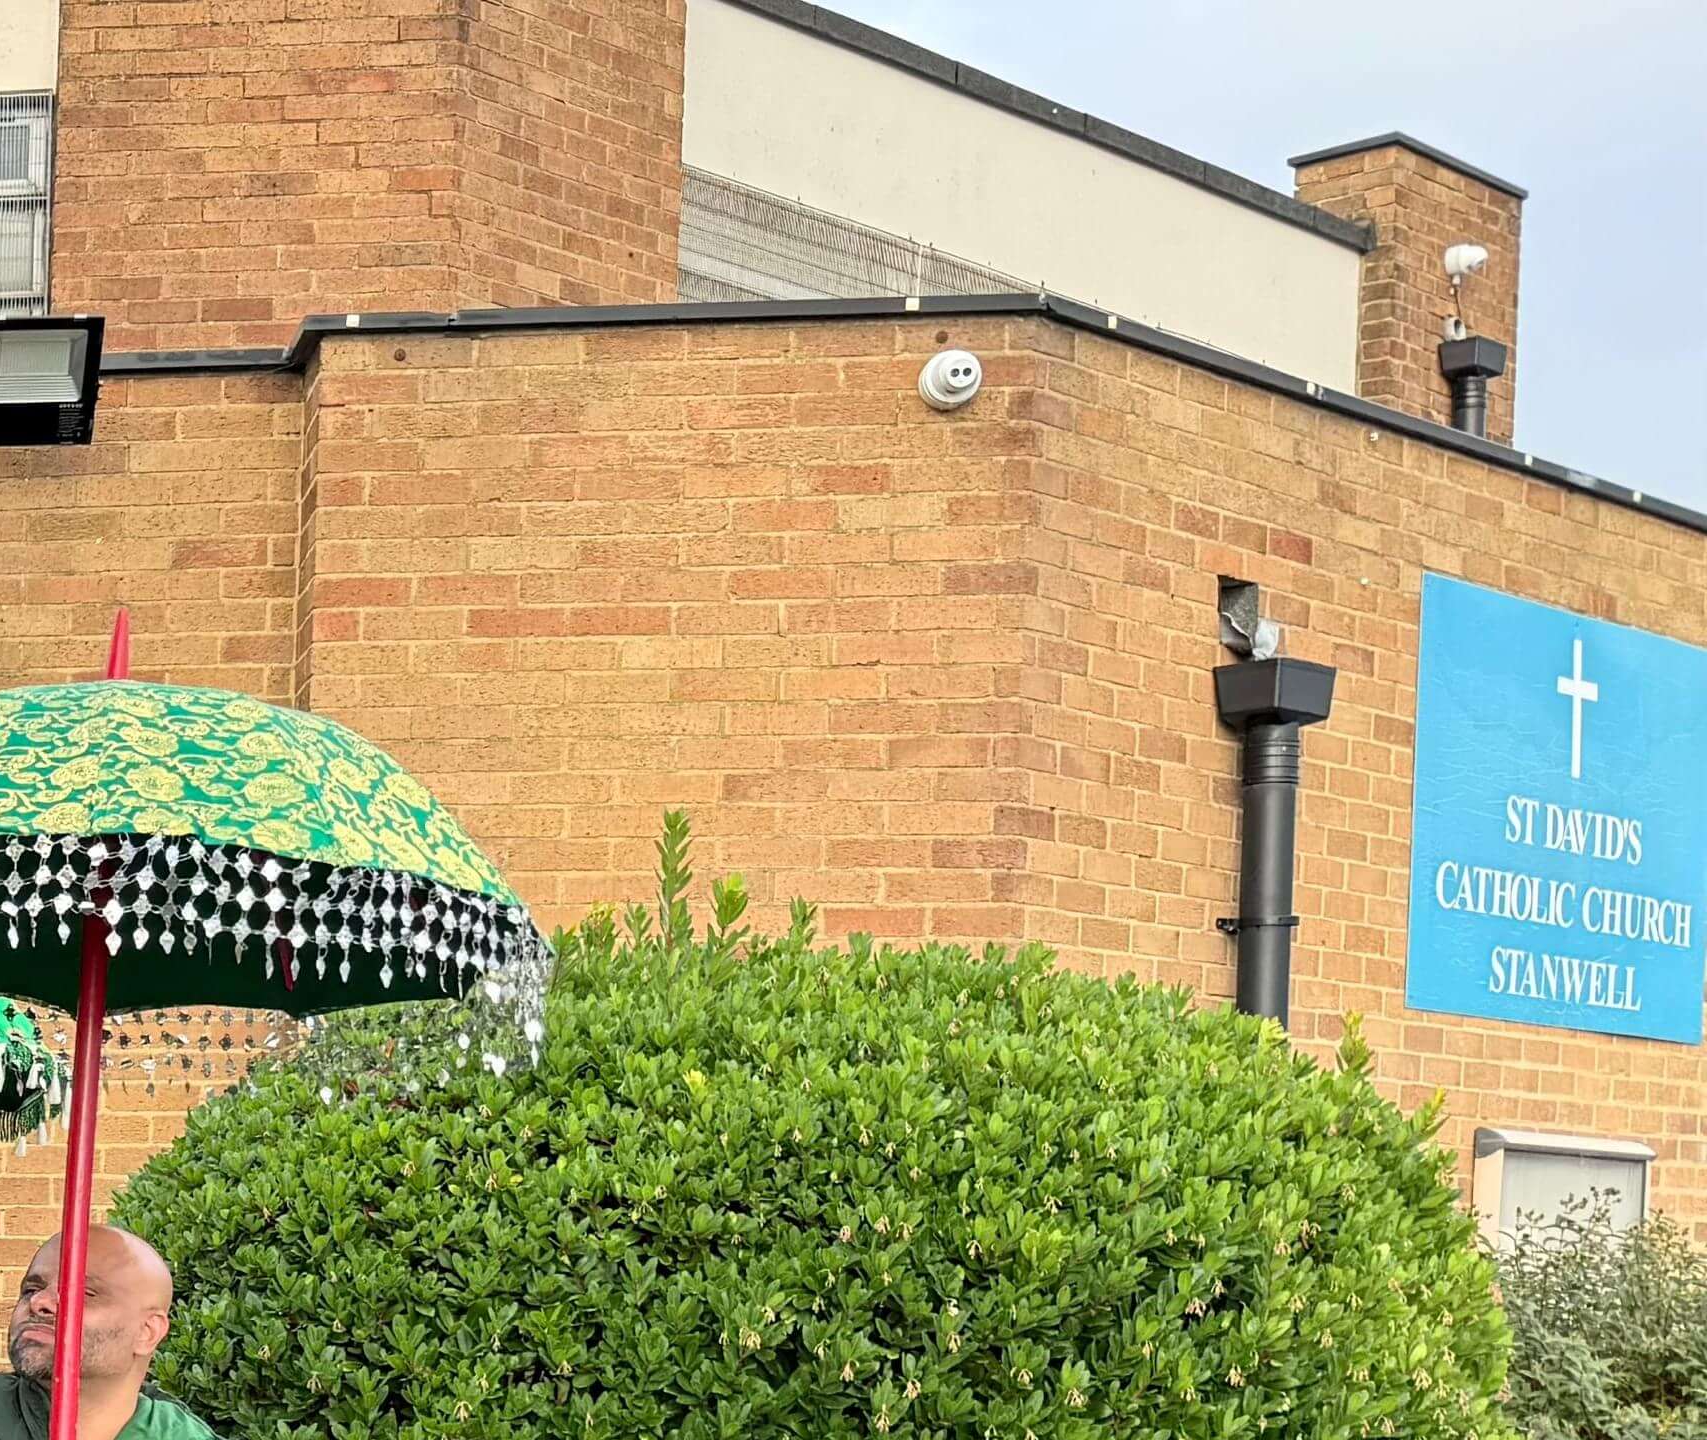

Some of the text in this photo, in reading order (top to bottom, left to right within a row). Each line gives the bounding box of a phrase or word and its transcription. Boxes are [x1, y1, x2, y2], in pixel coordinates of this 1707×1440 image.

[1505, 794, 1643, 866] ST DAVID'S
[1435, 860, 1692, 948] CATHOLIC CHURCH
[1489, 945, 1642, 1012] STANWELL
